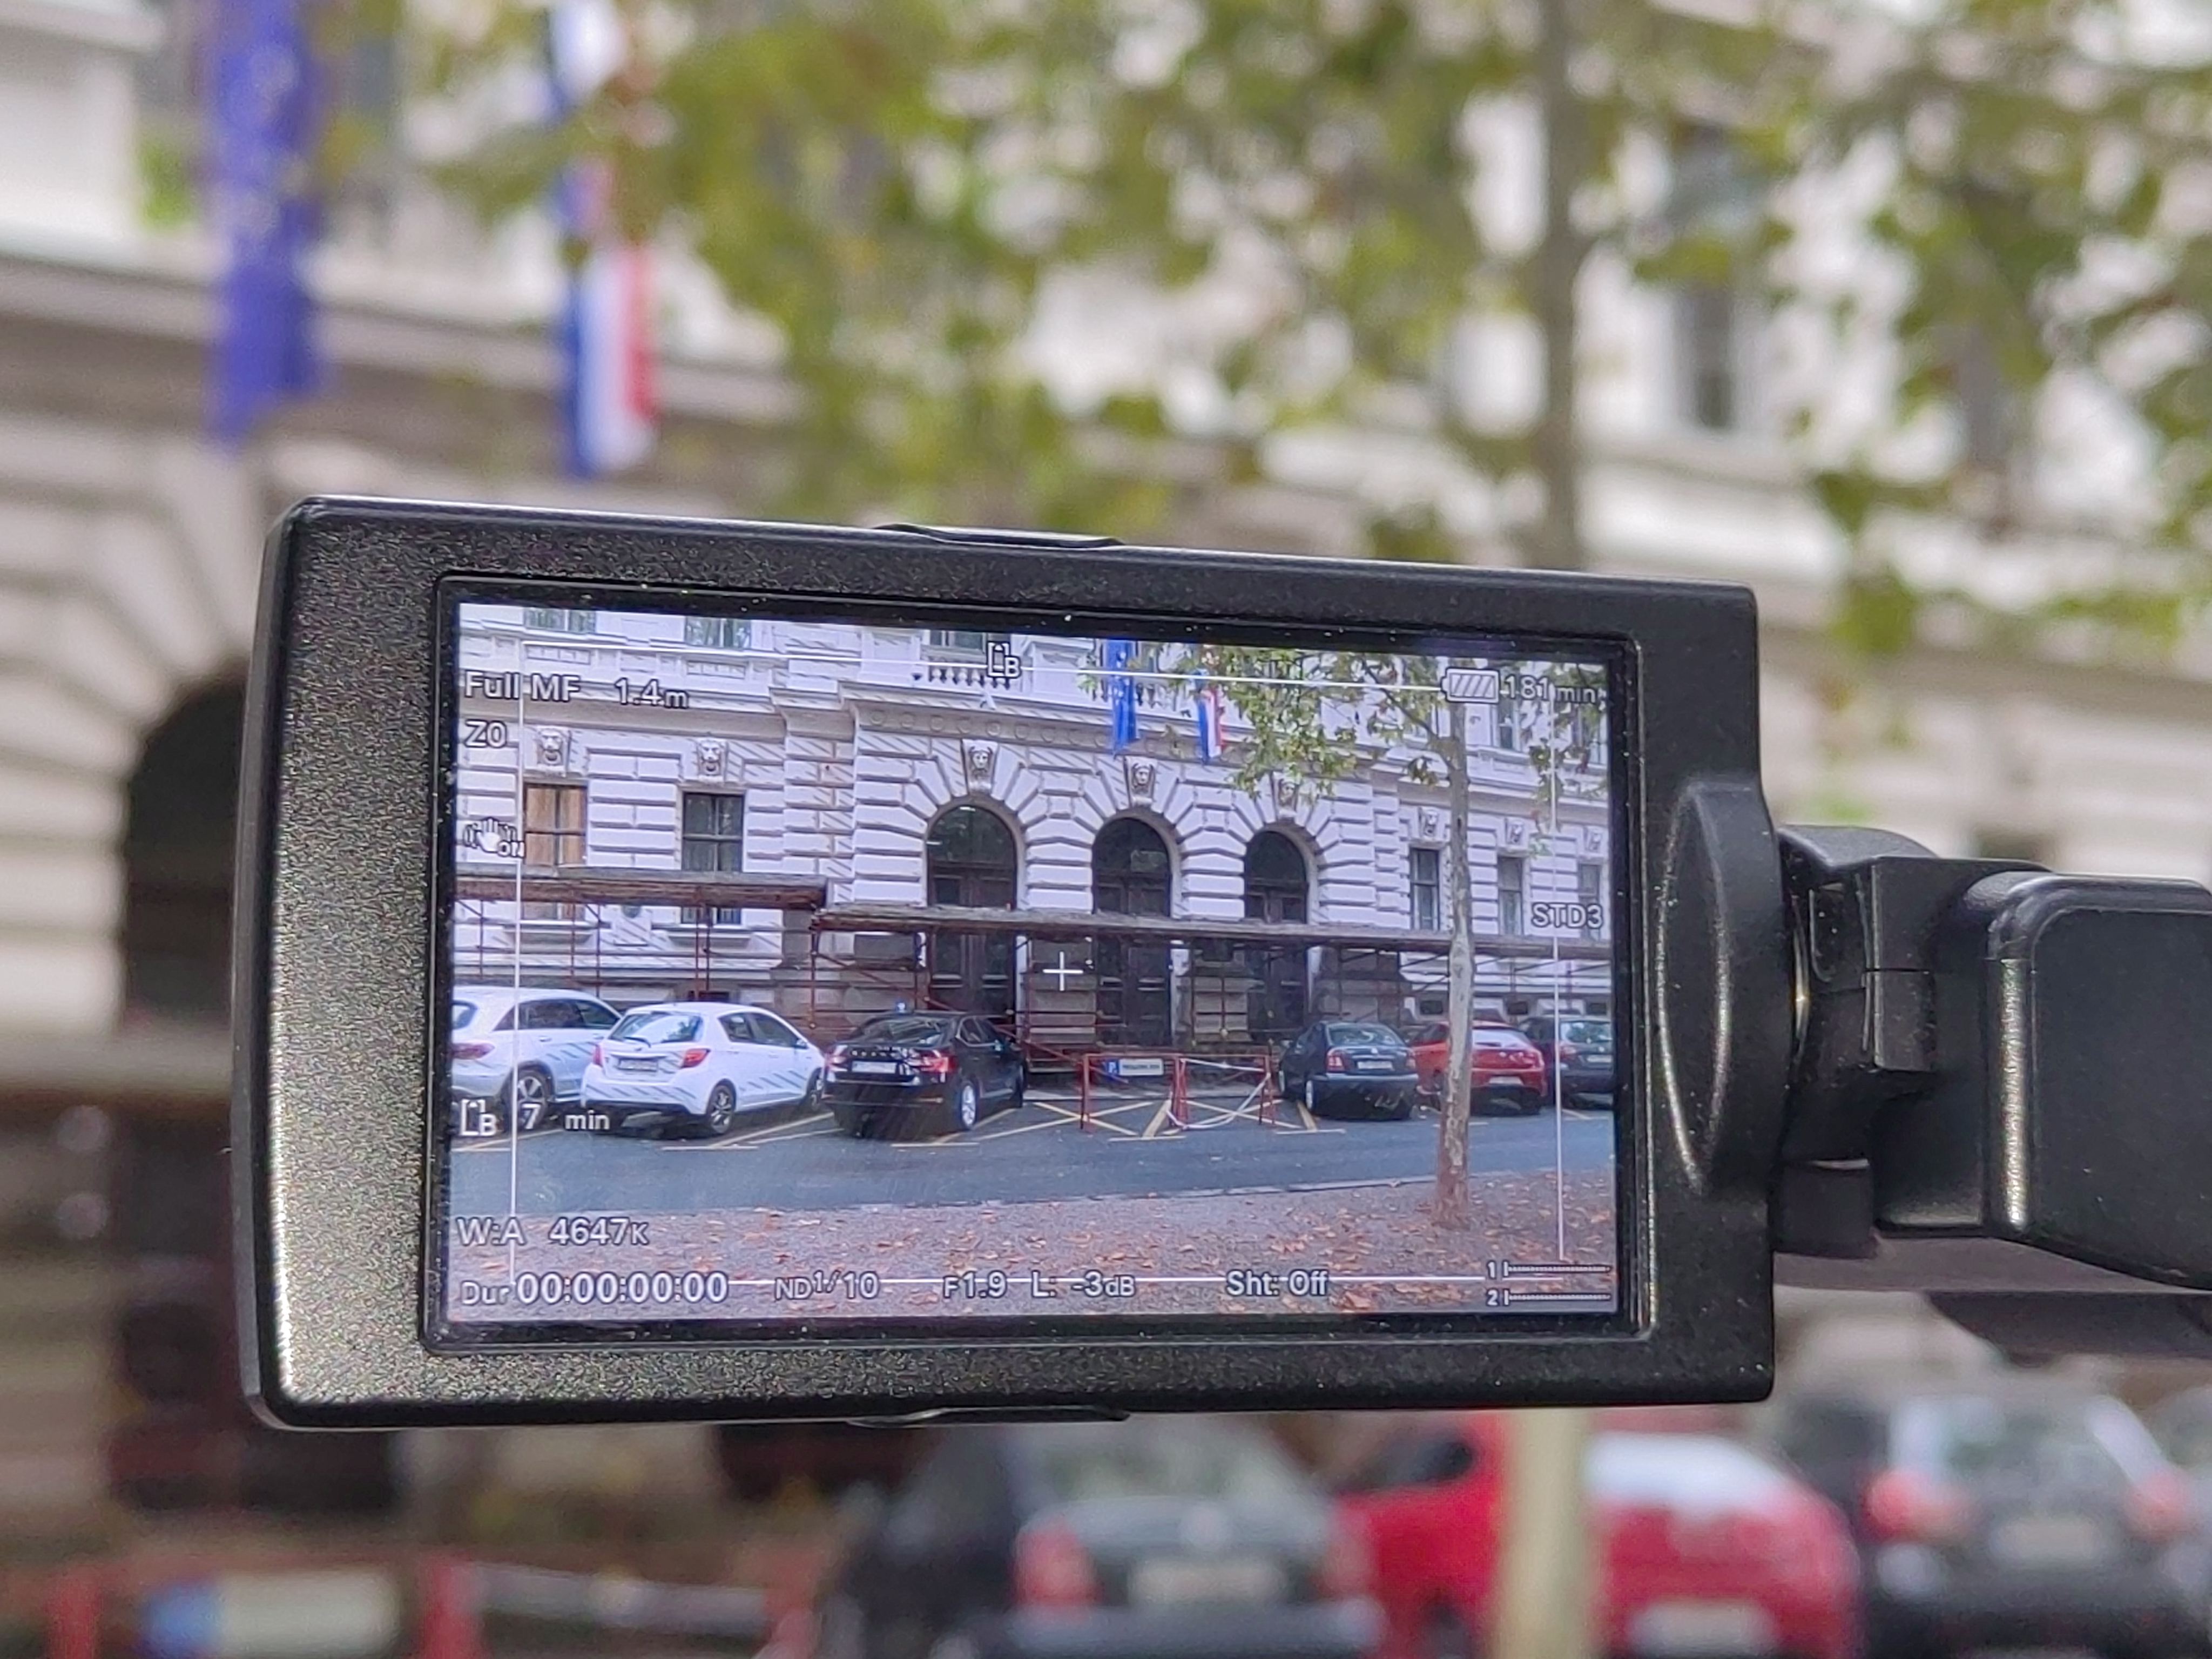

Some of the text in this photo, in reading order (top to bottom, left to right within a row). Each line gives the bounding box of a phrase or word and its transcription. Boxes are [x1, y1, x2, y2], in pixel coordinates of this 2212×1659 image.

[465, 670, 689, 708] Full MF 1.4m
[1505, 675, 1596, 703] 181 min
[1532, 902, 1603, 929] STD3
[521, 1103, 610, 1130] 7 min
[548, 1216, 650, 1245] 4647K
[1487, 1260, 1496, 1279] 1
[460, 1280, 510, 1305] Dur
[515, 1271, 729, 1304] 00:00:00:00
[942, 1270, 1007, 1299] F1.9
[1071, 1270, 1136, 1298] -3dB
[1226, 1269, 1279, 1297] Sht:
[1289, 1269, 1328, 1297] Off
[1486, 1288, 1499, 1306] 2
